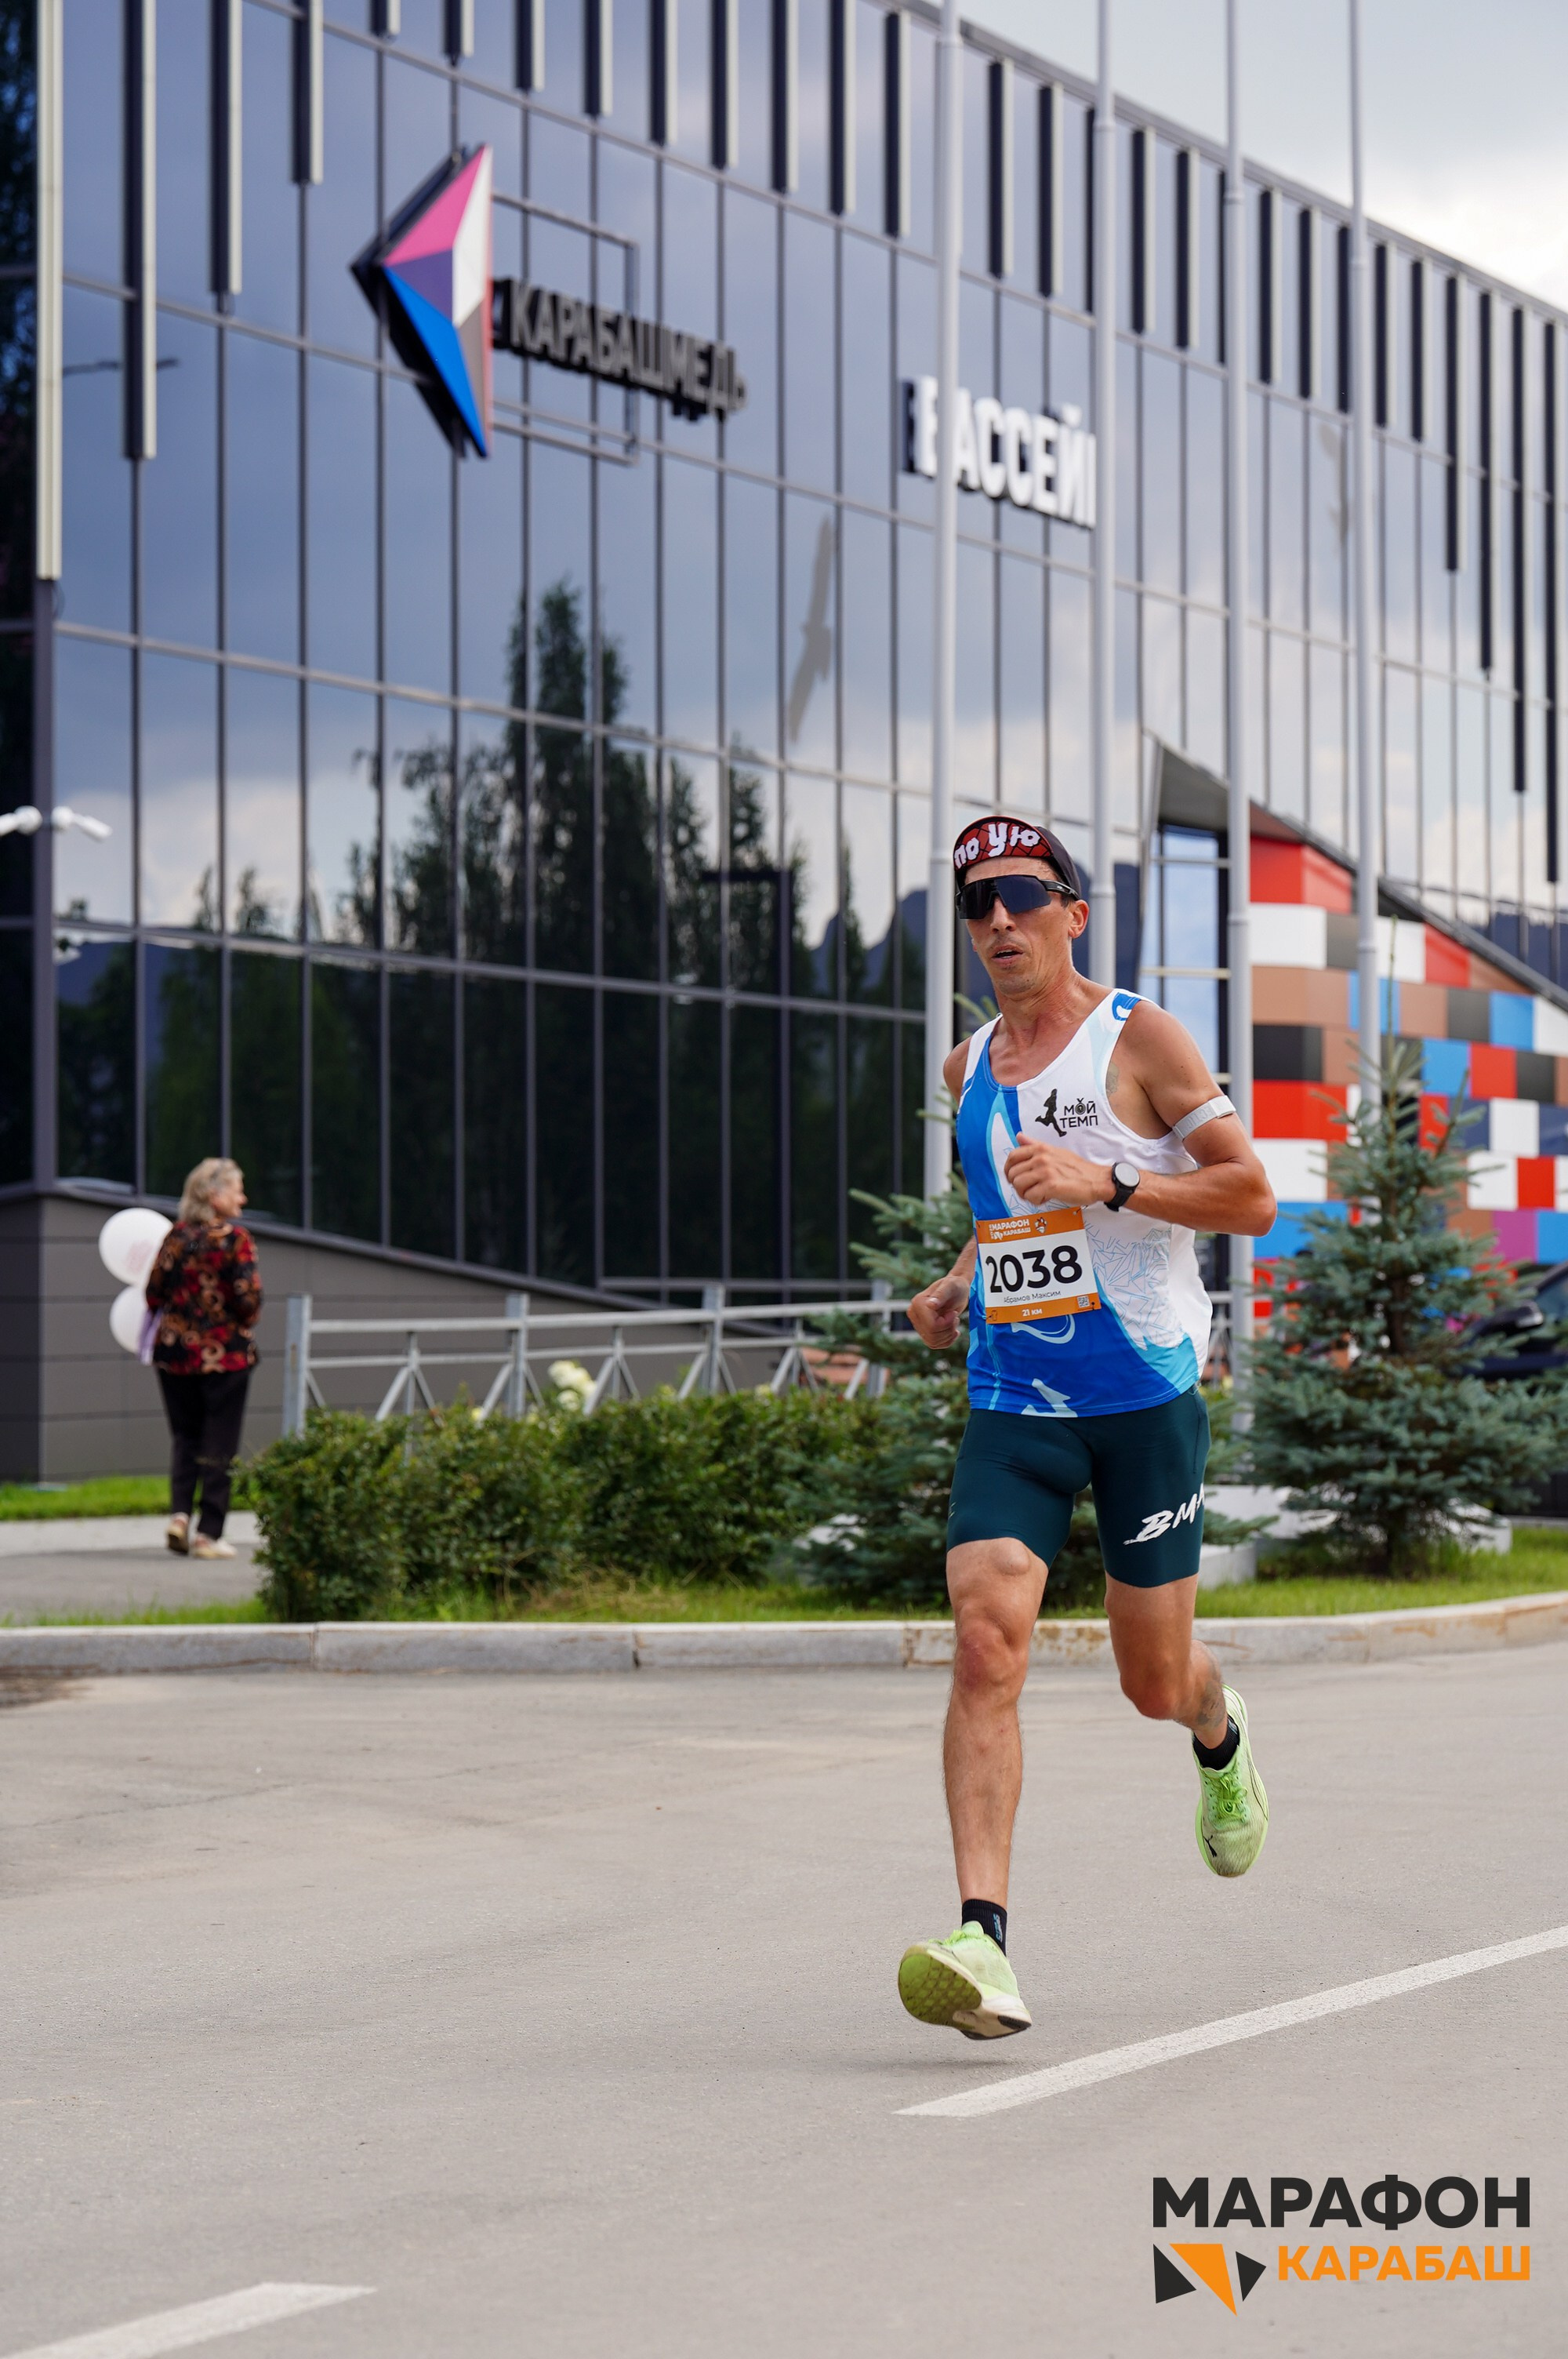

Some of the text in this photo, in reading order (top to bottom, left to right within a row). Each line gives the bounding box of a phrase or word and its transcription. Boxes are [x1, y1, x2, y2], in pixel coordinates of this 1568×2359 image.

[510, 278, 750, 414] КАРАБАШМЕДЬ
[1064, 1097, 1096, 1116] МОЙ
[1059, 1114, 1098, 1129] ТЕМП
[991, 1219, 1030, 1230] МАРАФОН
[985, 1245, 1083, 1293] 2038
[1031, 1290, 1062, 1300] Максим
[1022, 1308, 1030, 1317] 21
